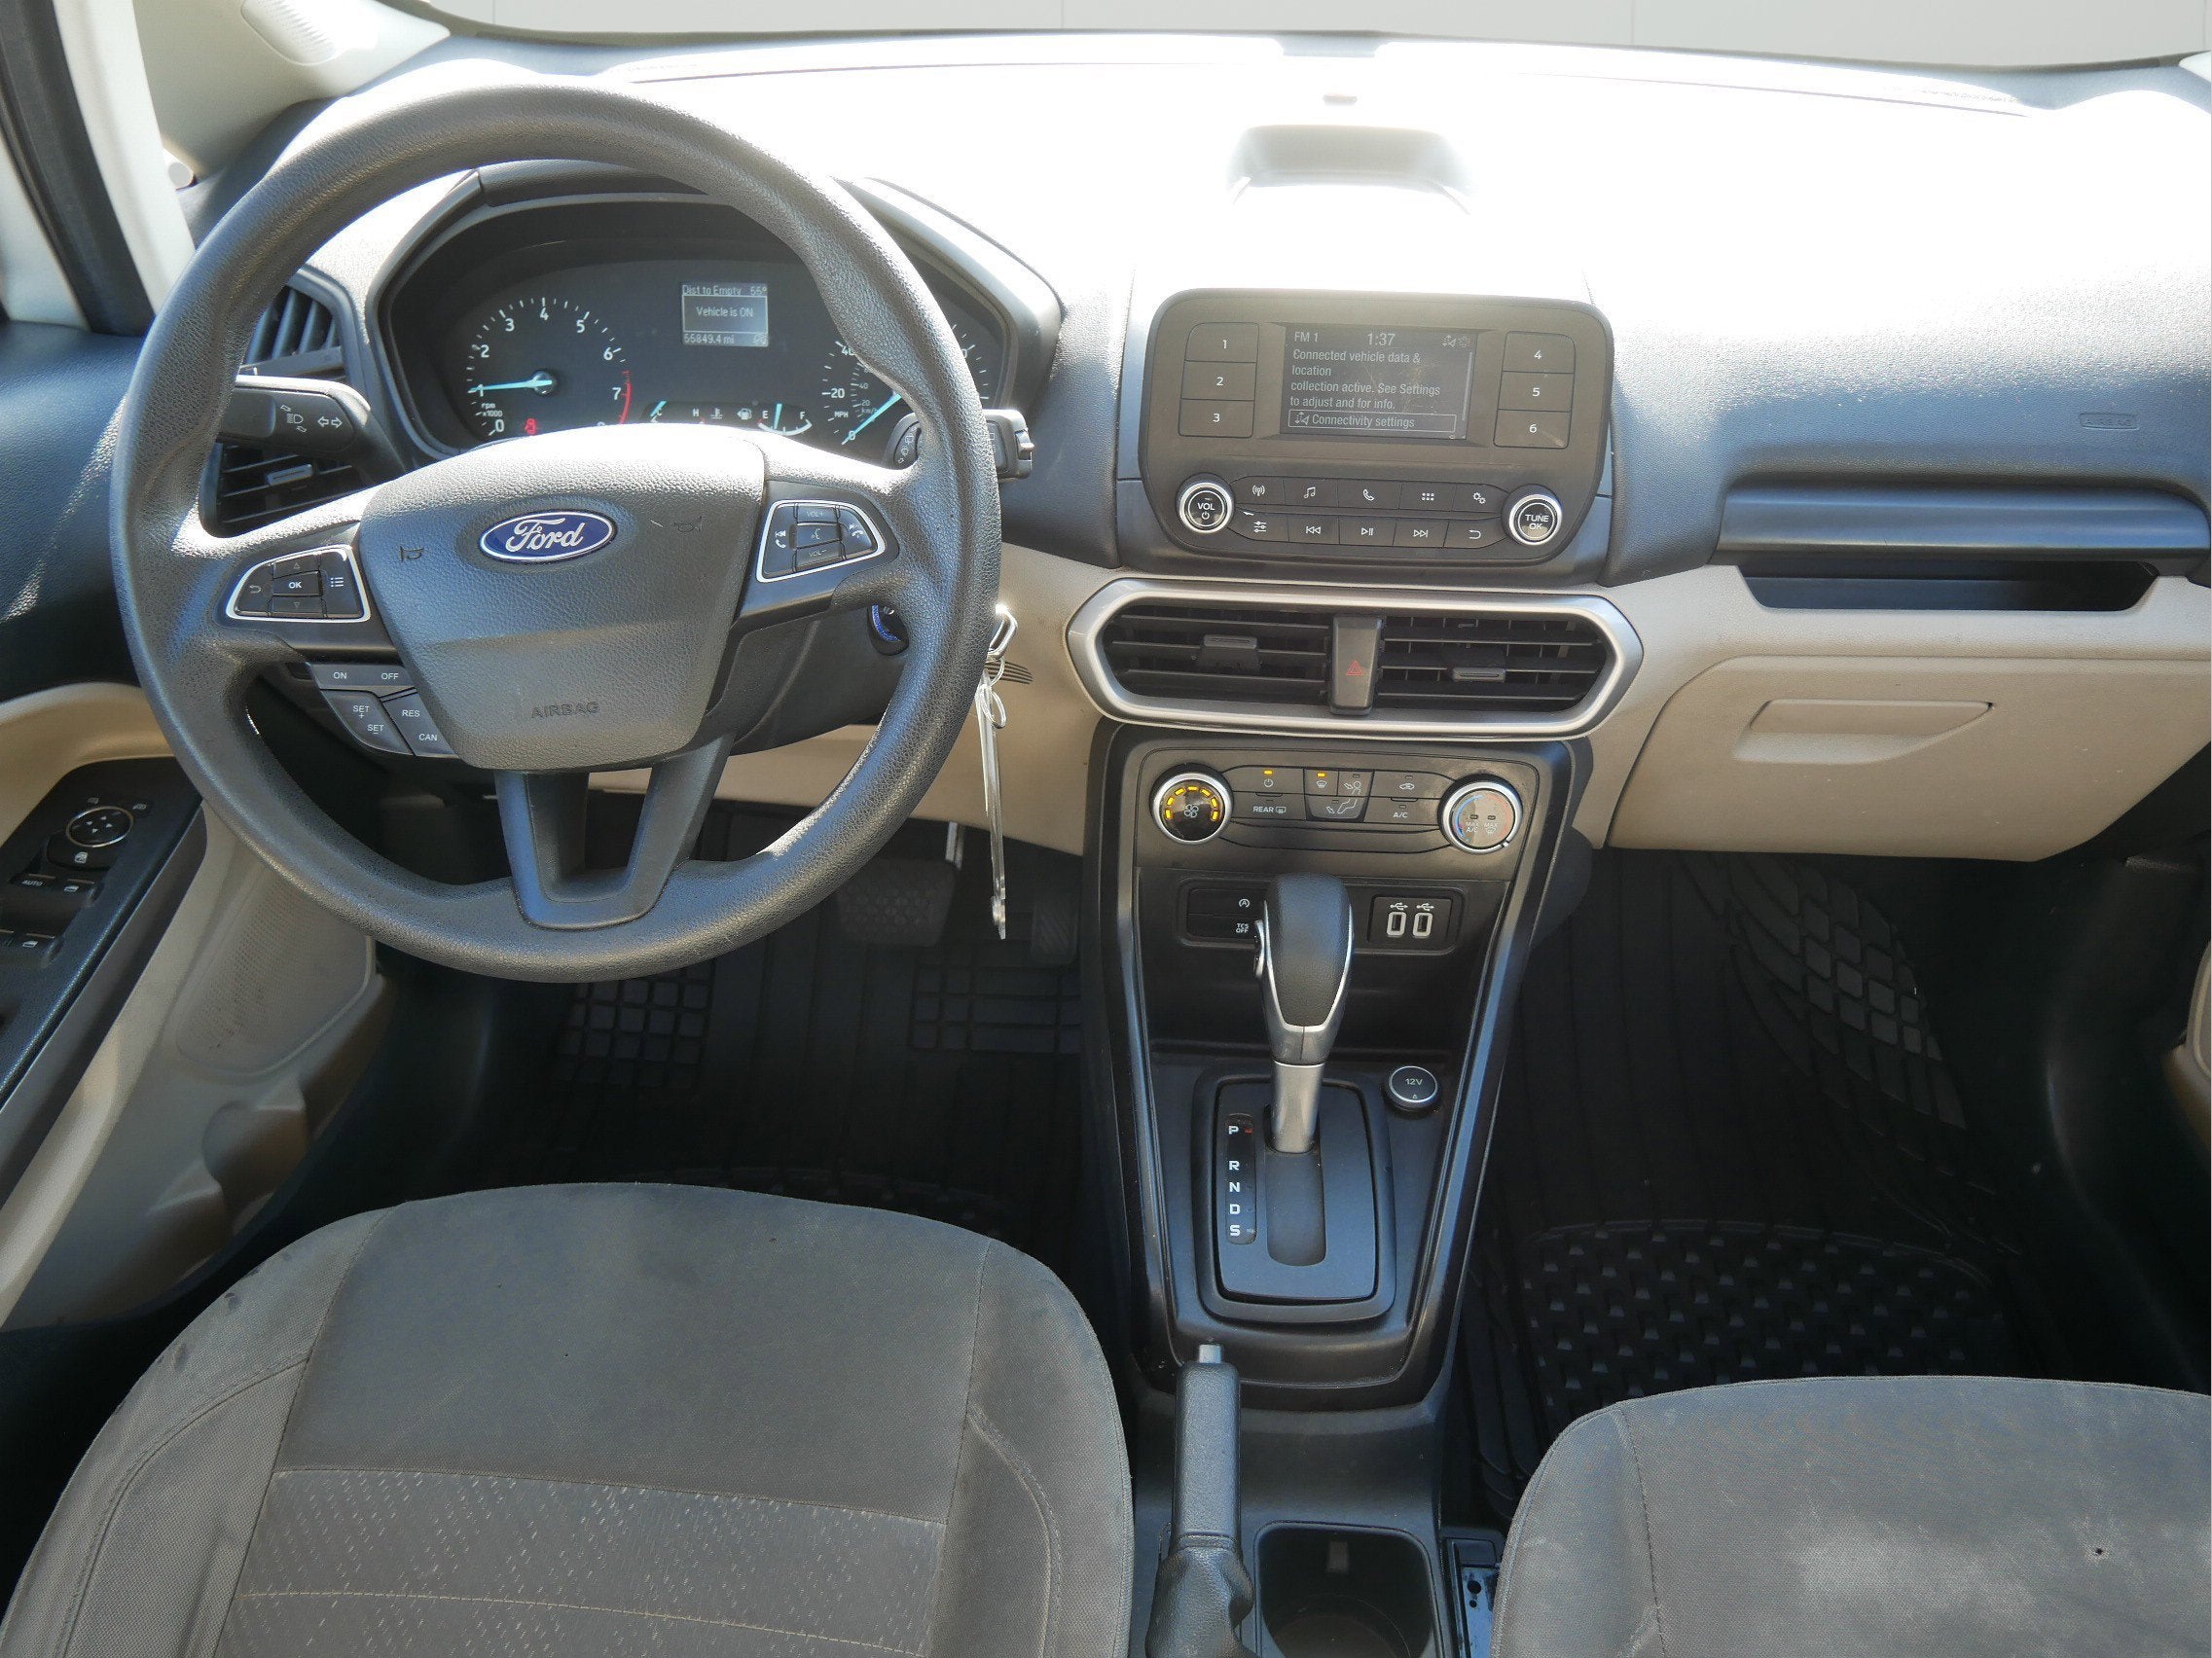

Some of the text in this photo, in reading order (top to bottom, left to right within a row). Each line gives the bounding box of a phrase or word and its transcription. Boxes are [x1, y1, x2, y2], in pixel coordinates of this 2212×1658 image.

[682, 285, 701, 295] Dist
[702, 286, 711, 295] to
[713, 285, 742, 296] Empty
[540, 307, 549, 321] 4
[696, 306, 754, 317] Vehicle is ON
[505, 318, 515, 332] 3
[576, 319, 585, 333] 5
[723, 334, 735, 344] mi
[1294, 332, 1319, 342] FM 1
[1367, 332, 1396, 346] 1:37
[1222, 339, 1228, 349] 1
[481, 344, 490, 358] 2
[603, 347, 613, 360] 6
[1293, 348, 1421, 364] Connected vehicle data &
[1533, 350, 1542, 361] 4
[1291, 365, 1331, 377] location
[1216, 377, 1224, 387] 2
[612, 387, 622, 400] 7
[831, 388, 845, 399] 20
[1290, 380, 1440, 396] collection active. See Settings
[1533, 387, 1541, 398] 5
[1290, 396, 1396, 410] to adjust and for info.
[692, 409, 700, 417] H
[762, 411, 768, 419] E
[1213, 413, 1220, 423] 3
[495, 418, 505, 433] 0
[1312, 414, 1415, 429] Connectivity settings
[1529, 423, 1538, 434] 6
[1197, 502, 1215, 511] VOL
[1525, 514, 1549, 523] TUNE
[505, 517, 586, 553] Ford
[288, 581, 302, 590] OK
[333, 671, 347, 680] ON
[352, 704, 370, 713] SET
[402, 709, 420, 718] RES
[532, 701, 600, 719] AIRBAG
[418, 733, 438, 741] CAN
[1405, 1077, 1423, 1086] 12V
[1228, 1125, 1239, 1135] P
[1229, 1161, 1240, 1171] R
[1229, 1182, 1240, 1192] N
[1229, 1204, 1241, 1215] D
[1229, 1225, 1241, 1237] S
